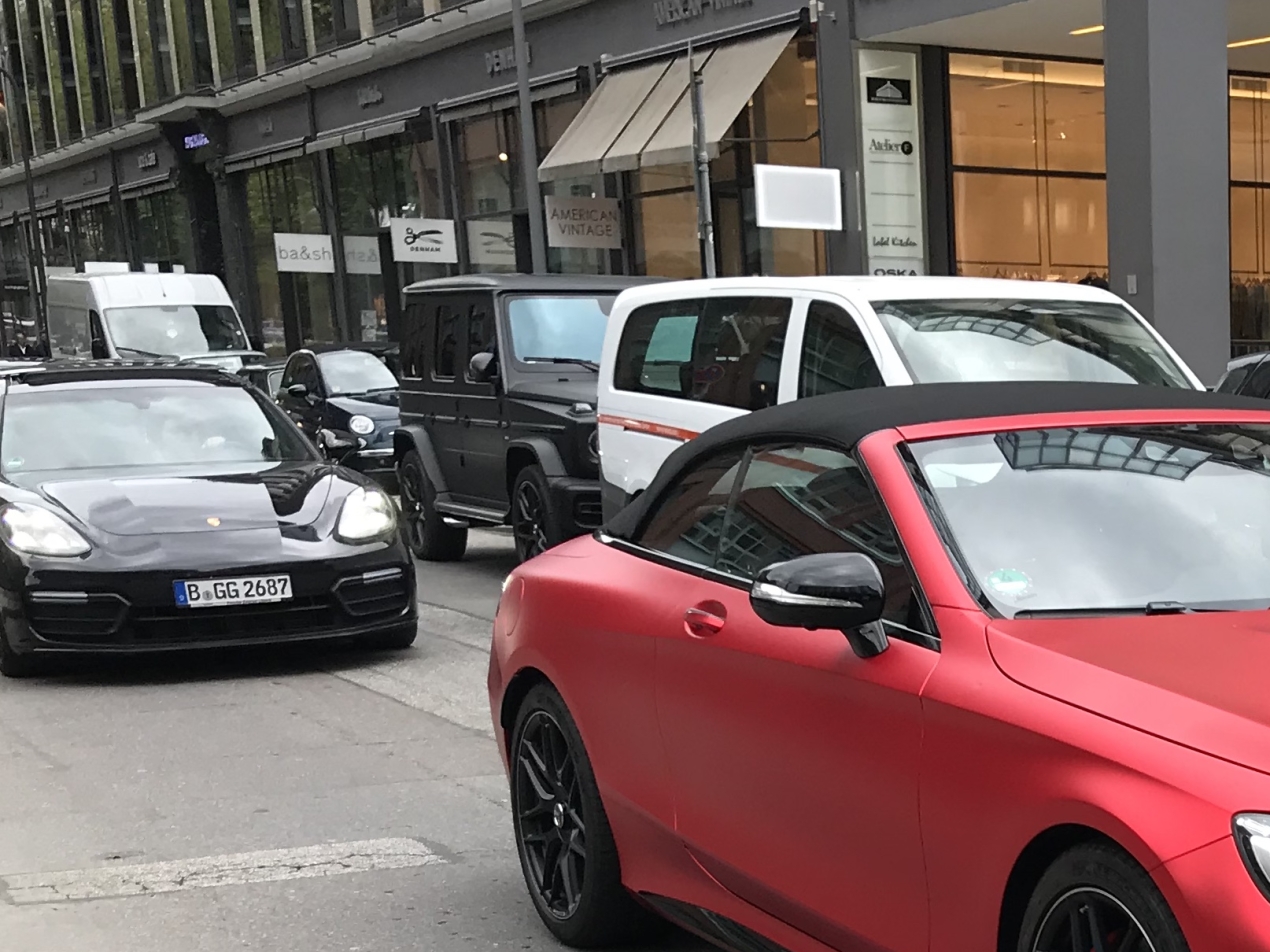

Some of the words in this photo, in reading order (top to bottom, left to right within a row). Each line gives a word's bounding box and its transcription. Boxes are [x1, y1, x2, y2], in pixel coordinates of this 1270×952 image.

[869, 138, 902, 152] Atelier
[551, 207, 618, 222] AMERICAN
[558, 223, 613, 237] VINTAGE
[278, 245, 332, 261] ba&sh
[187, 584, 201, 601] B
[213, 582, 239, 599] GG
[243, 578, 288, 597] 2687
